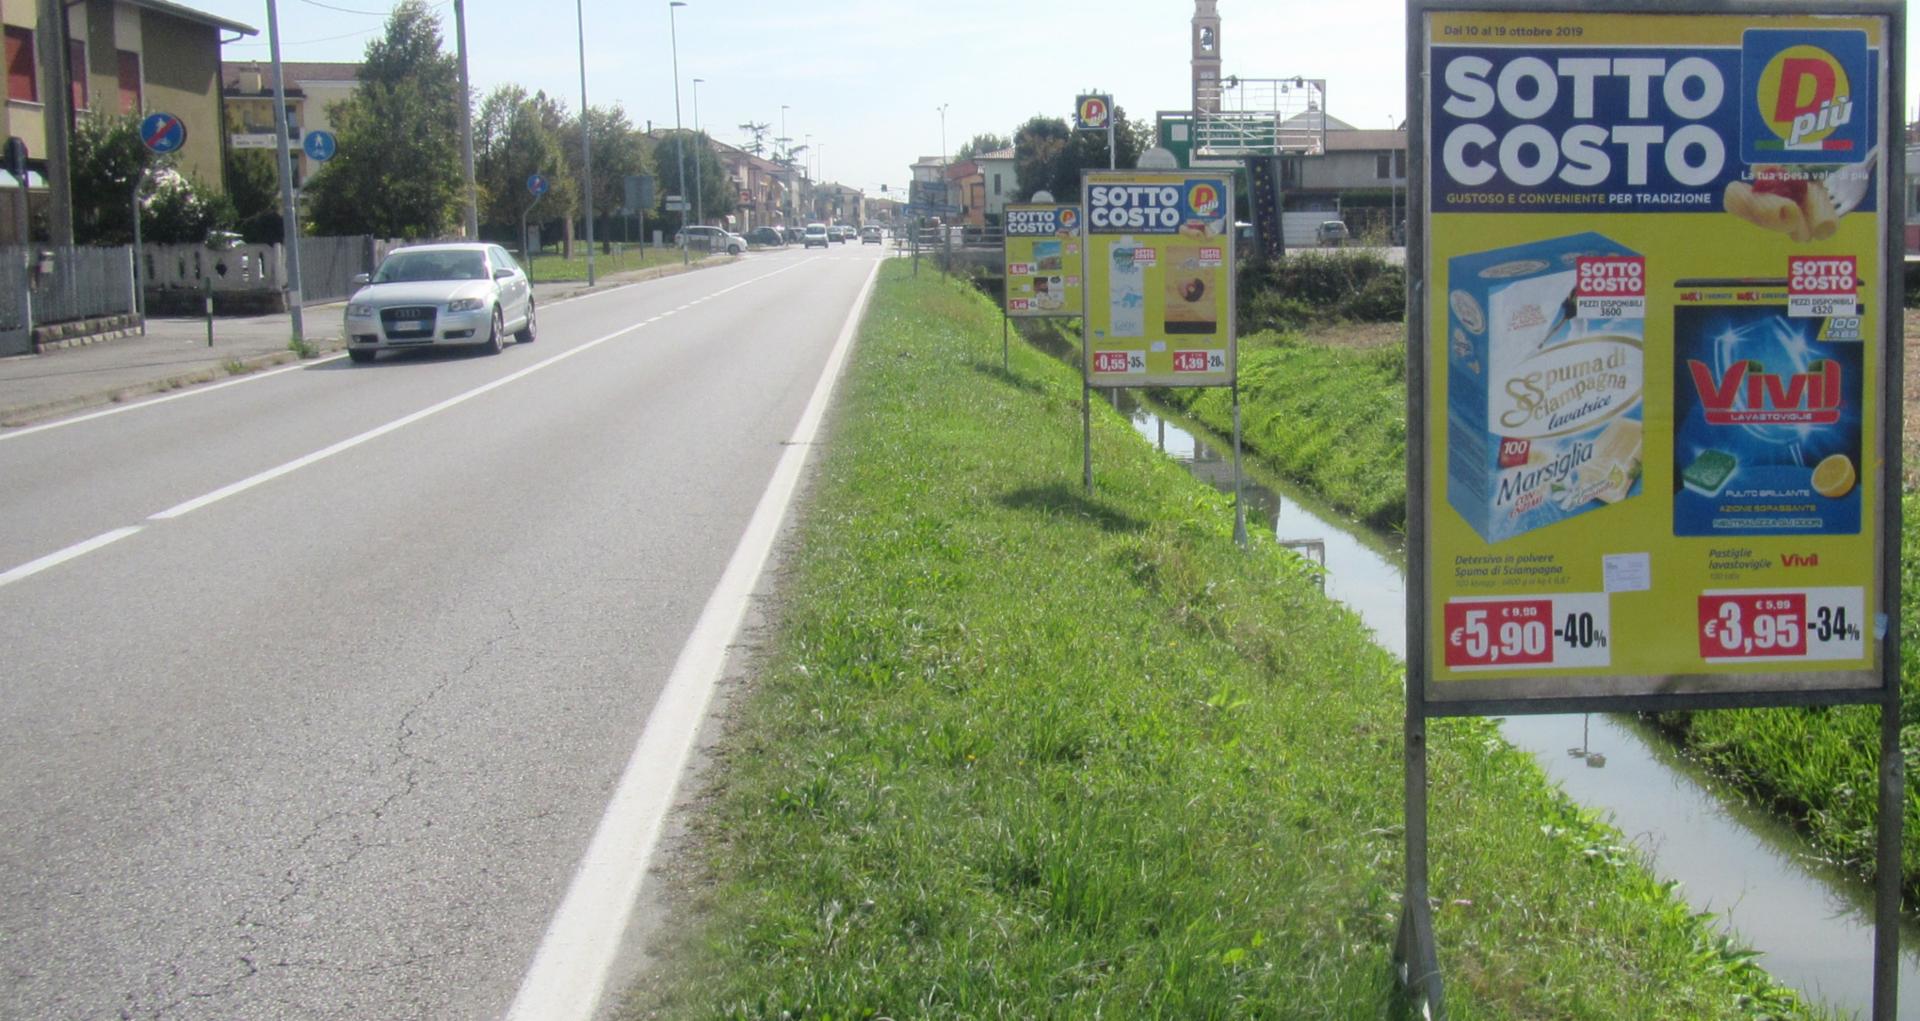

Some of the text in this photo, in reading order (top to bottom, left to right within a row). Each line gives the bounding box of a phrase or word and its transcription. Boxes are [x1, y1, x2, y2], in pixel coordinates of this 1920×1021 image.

[1444, 25, 1584, 37] Dal 10 al 19 ottobre 2019
[1442, 55, 1725, 120] SOTTO
[1774, 58, 1836, 123] D
[1788, 95, 1853, 147] più
[1442, 123, 1726, 187] COSTO
[1741, 170, 1754, 181] La
[1757, 170, 1775, 181] tua
[1778, 170, 1809, 183] spesa
[1091, 187, 1179, 207] SOTTO
[1446, 193, 1712, 205] GUSTOSO E CONVENIENTE PER TRADIZIONE
[1007, 211, 1055, 222] SOTTO
[1091, 207, 1181, 227] COSTO
[1007, 222, 1056, 233] COSTO
[1580, 262, 1642, 277] SOTTO
[1791, 260, 1853, 275] SOTTO
[1580, 277, 1642, 292] COSTO
[1791, 276, 1853, 290] COSTO
[1578, 299, 1643, 308] PEZZI DISPONIBILI
[1790, 297, 1811, 306] PEZZI
[1811, 305, 1833, 315] 4320
[1829, 318, 1860, 329] 100
[1606, 347, 1626, 369] di
[1687, 359, 1842, 411] Vivil
[1501, 373, 1627, 428] Sciampagna
[1548, 394, 1612, 431] lavatrice
[1730, 413, 1813, 422] LAVASTOVIGLIE
[1503, 440, 1528, 455] 100
[1497, 442, 1594, 506] Marsiglia
[1759, 489, 1811, 497] BRILLANTE
[1455, 554, 1554, 566] Detersivo in polvere
[1708, 549, 1752, 561] Pastiglie
[1781, 554, 1819, 568] Vivil
[1455, 565, 1563, 578] Spuma di Sciampagna
[1708, 559, 1772, 571] lavastoviglie
[1554, 612, 1607, 649] -40%
[1807, 606, 1860, 642] -34%
